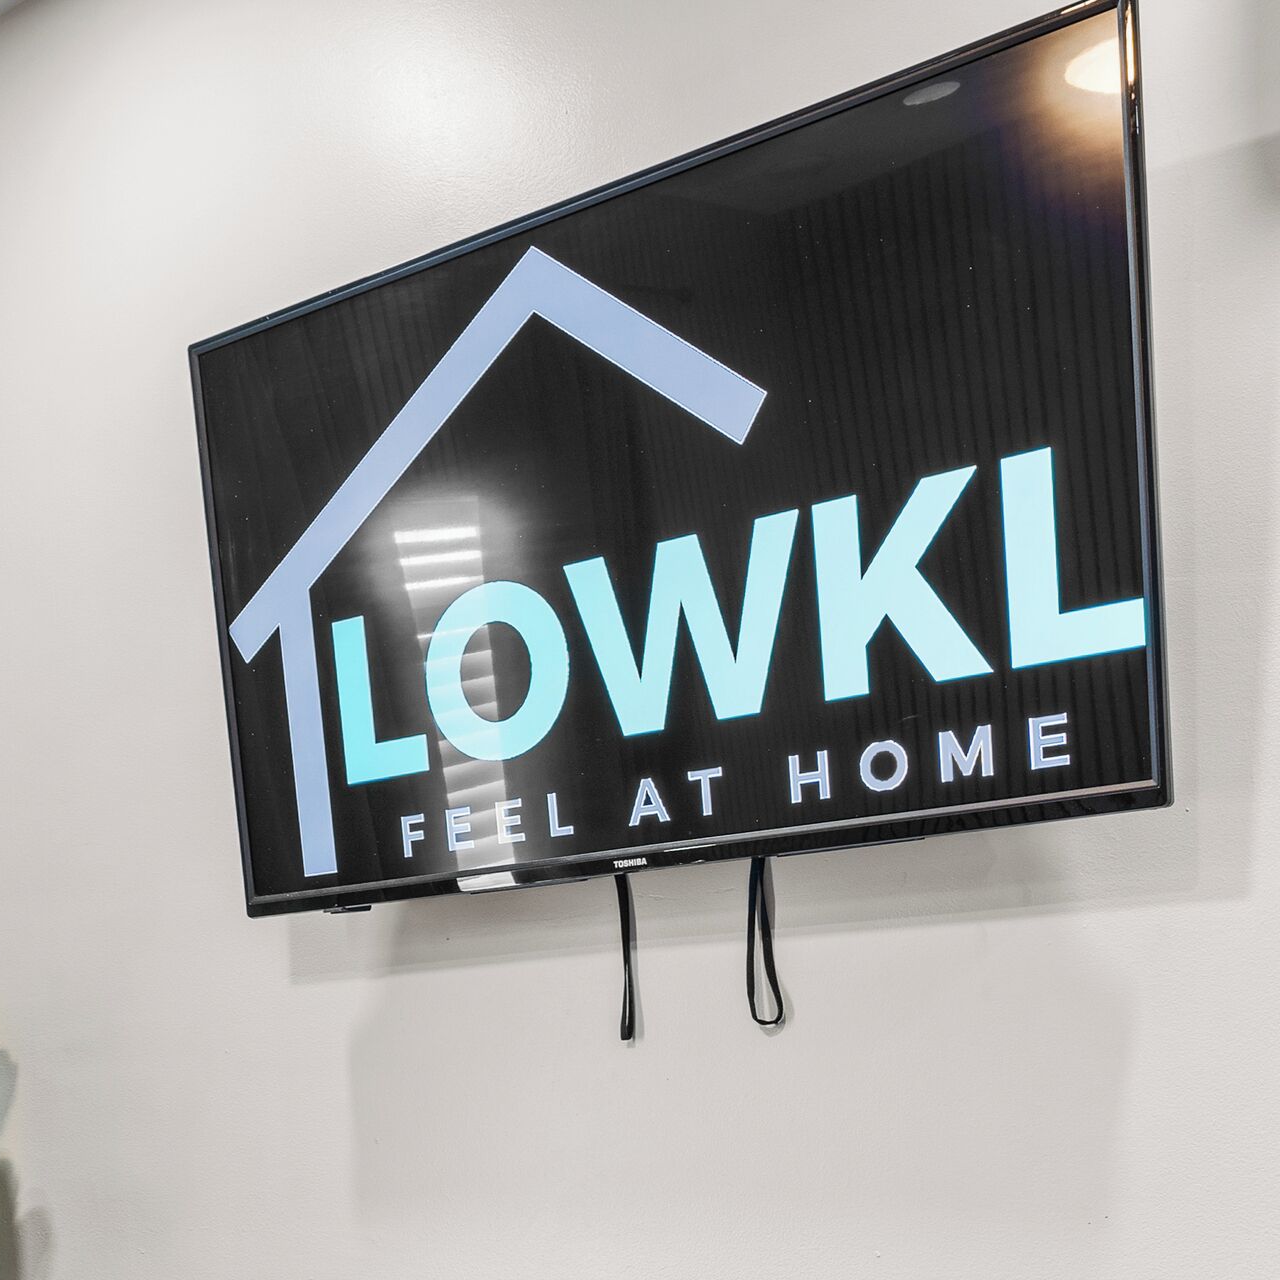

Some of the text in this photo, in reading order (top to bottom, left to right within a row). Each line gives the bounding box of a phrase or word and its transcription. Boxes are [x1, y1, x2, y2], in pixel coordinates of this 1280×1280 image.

[331, 447, 1147, 785] LOWKL
[400, 712, 1071, 859] FEEL AT HOME
[613, 857, 648, 868] TOSHIBA
